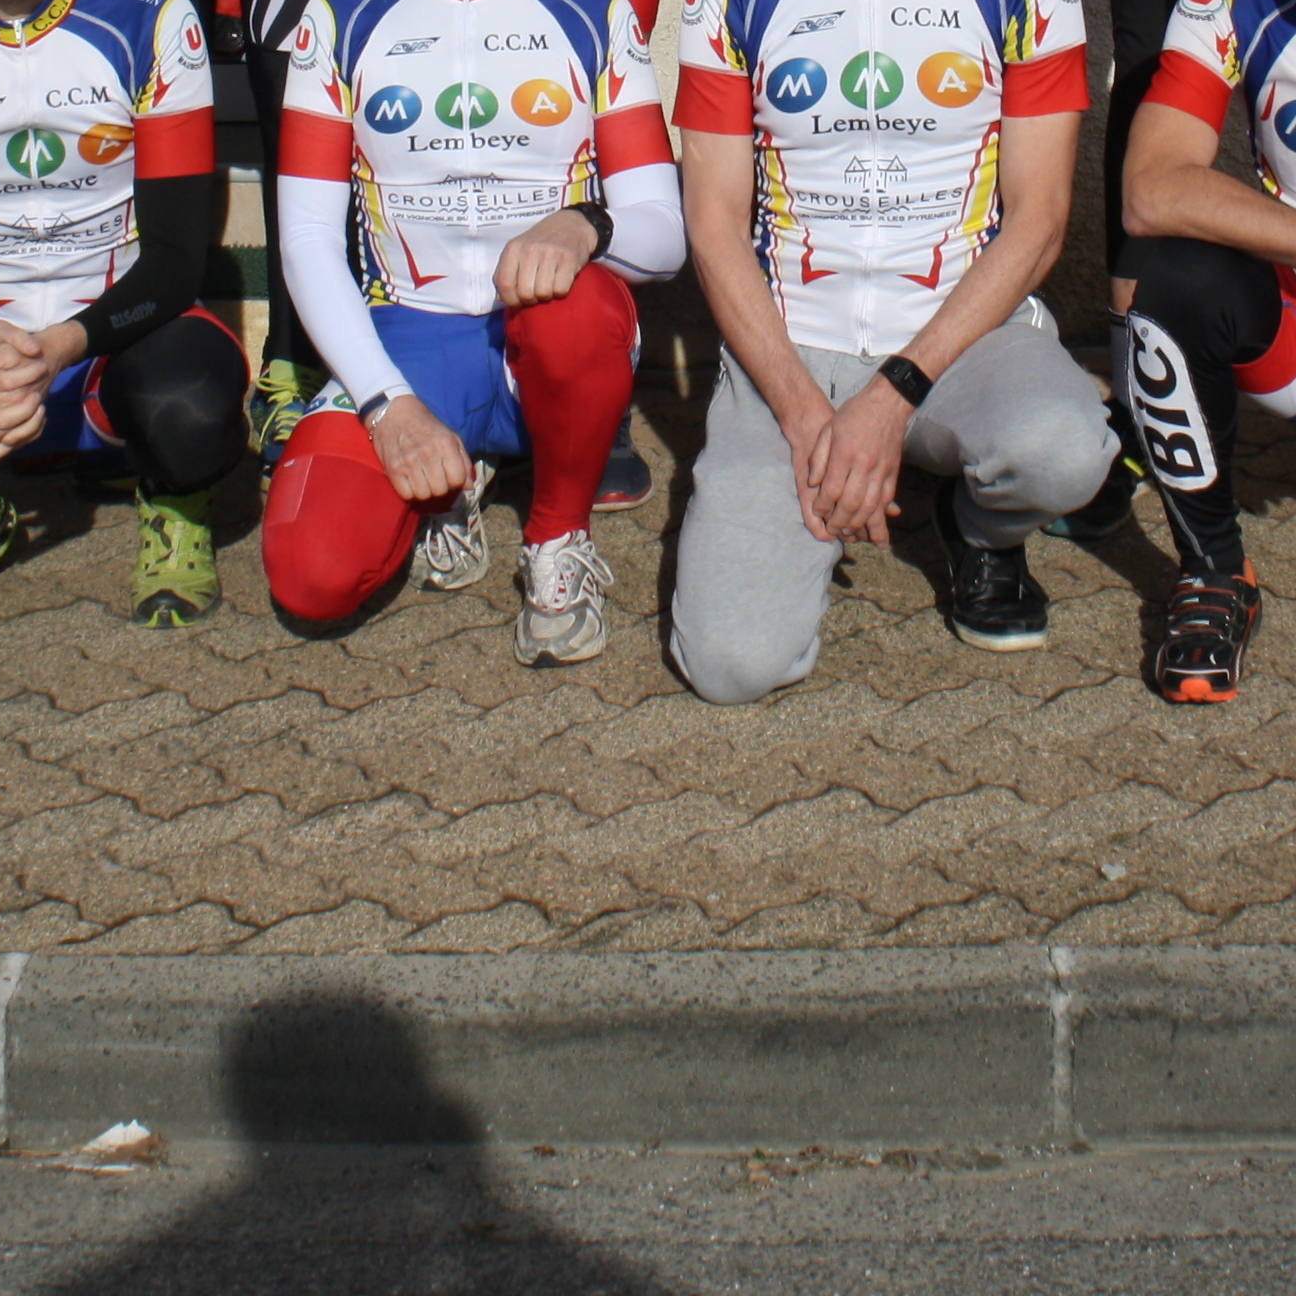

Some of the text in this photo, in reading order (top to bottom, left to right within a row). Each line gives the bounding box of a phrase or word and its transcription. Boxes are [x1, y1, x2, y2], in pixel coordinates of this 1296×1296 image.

[891, 7, 960, 28] C.C.M
[484, 34, 549, 51] C.C.M
[46, 86, 111, 107] C.C.M
[812, 115, 937, 137] Lembeye
[408, 132, 530, 152] Lembeye
[388, 187, 559, 208] CROUSEILLES
